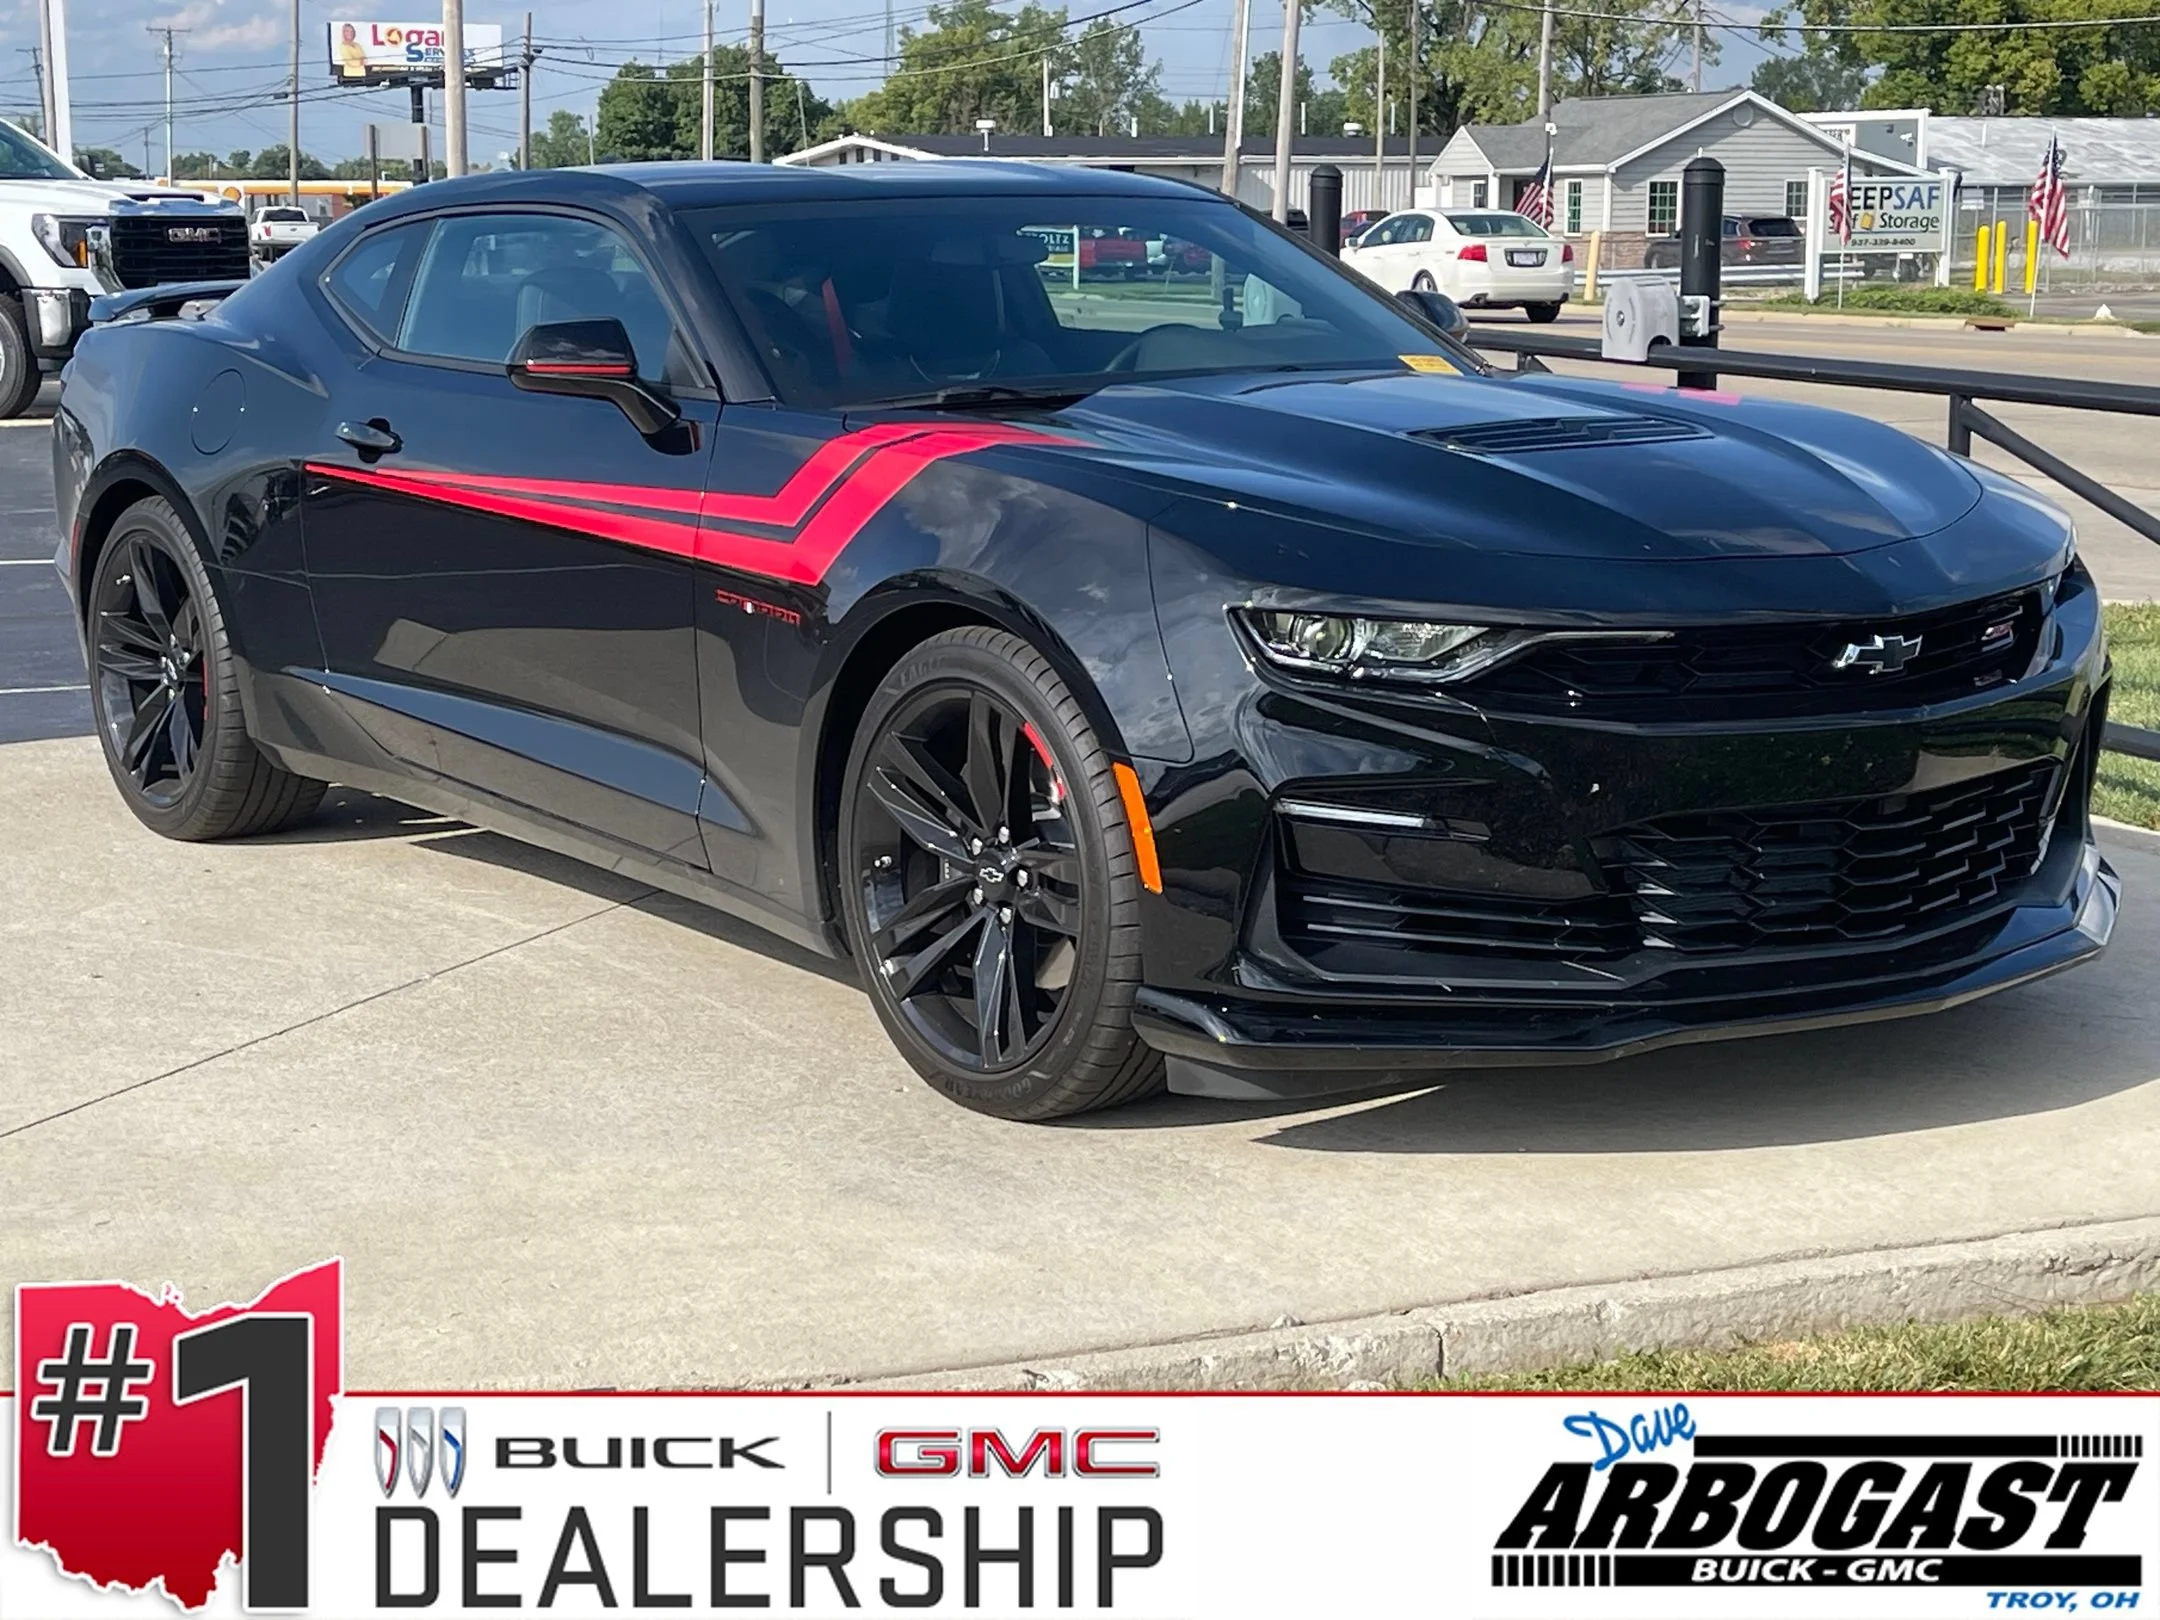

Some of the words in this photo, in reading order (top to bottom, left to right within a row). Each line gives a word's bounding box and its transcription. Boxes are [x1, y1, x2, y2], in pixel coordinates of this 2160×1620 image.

[1829, 186, 1941, 210] EEPSAF
[1879, 212, 1940, 232] Storage
[168, 227, 221, 243] GMC
